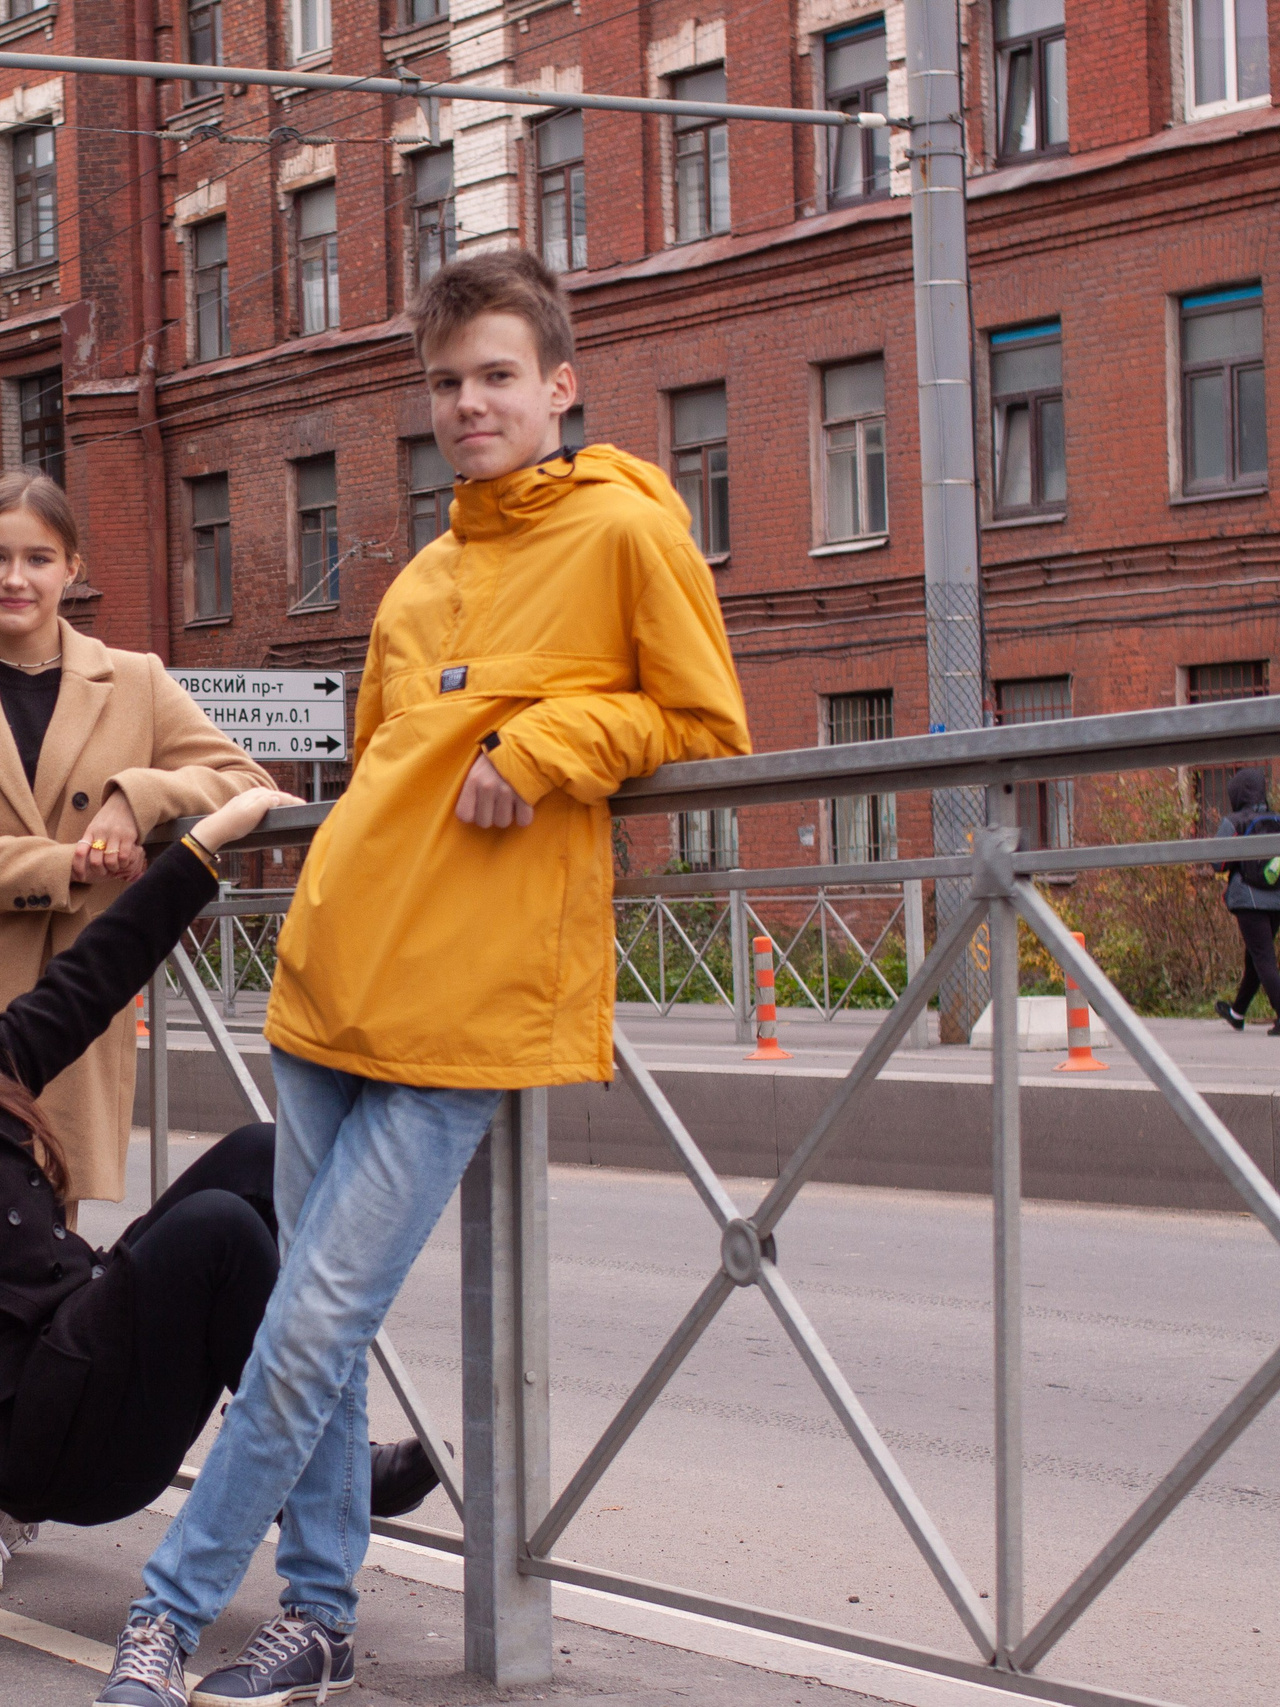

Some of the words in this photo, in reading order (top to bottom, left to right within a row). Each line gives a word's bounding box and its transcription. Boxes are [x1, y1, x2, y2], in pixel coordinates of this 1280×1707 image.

[176, 674, 246, 694] ОВСКИЙ
[251, 682, 284, 698] пр-т
[258, 741, 281, 752] пл.
[290, 737, 313, 753] 0.9
